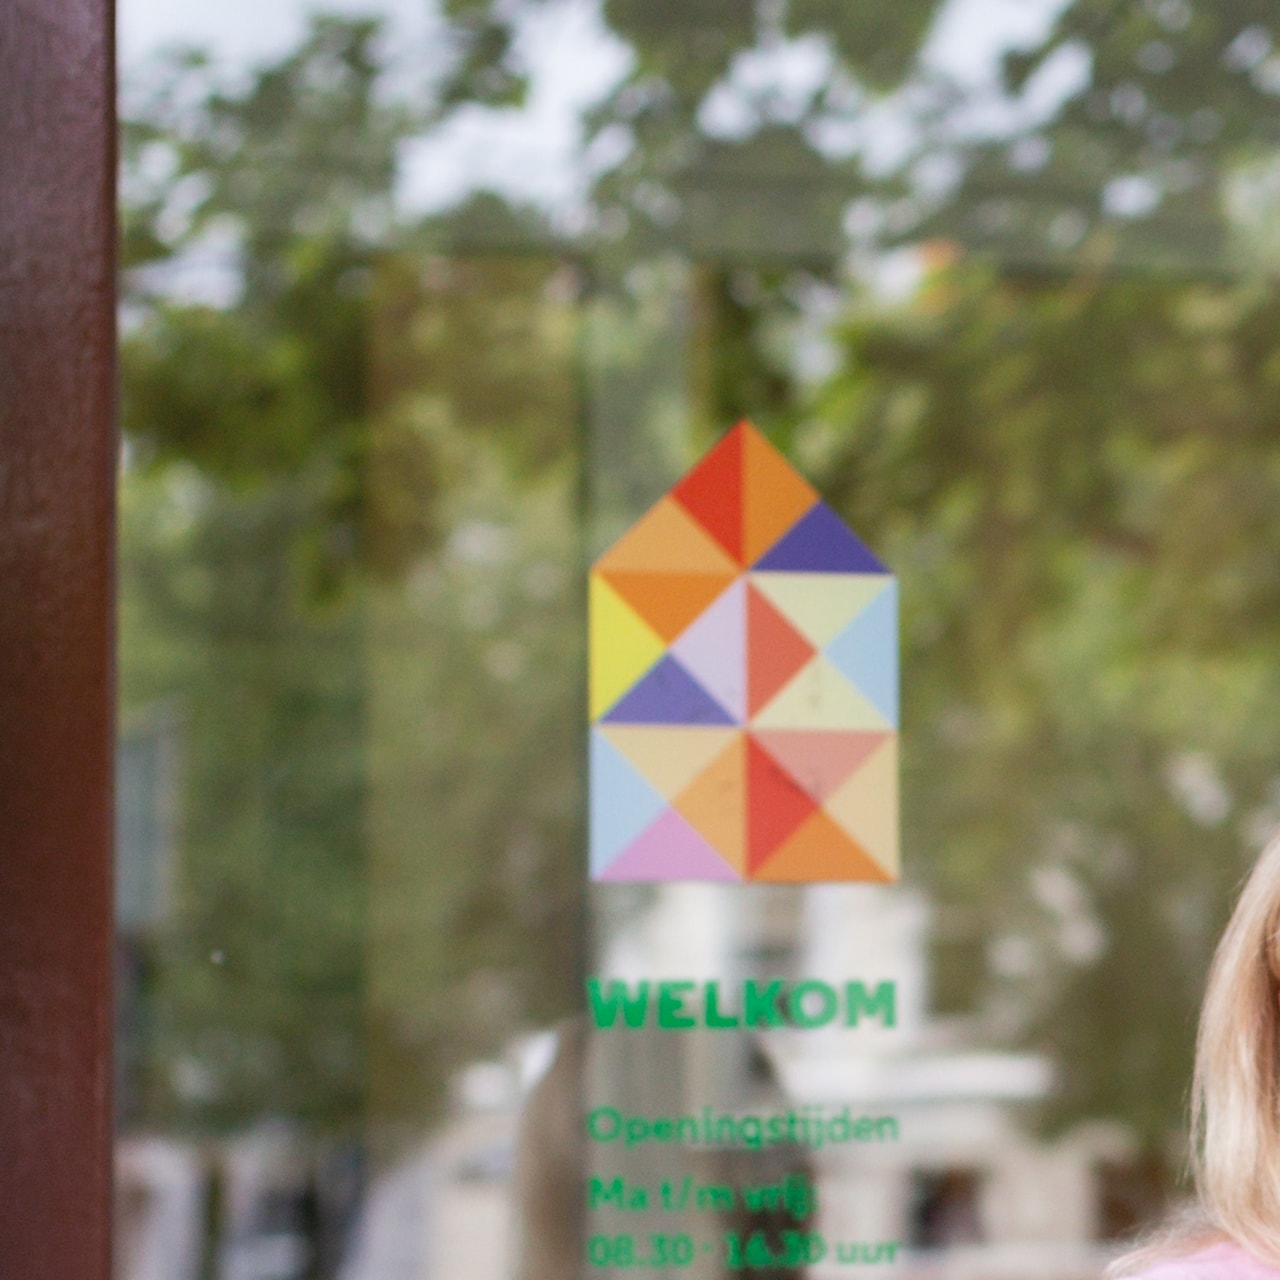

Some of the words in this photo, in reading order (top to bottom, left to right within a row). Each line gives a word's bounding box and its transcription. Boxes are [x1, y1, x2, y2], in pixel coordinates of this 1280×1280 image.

[585, 978, 898, 1029] WELKOM
[587, 1105, 899, 1151] Openingstijden
[588, 1175, 648, 1212] Ma
[660, 1175, 734, 1212] t/m
[588, 1233, 695, 1269] 08.30
[725, 1233, 828, 1269] 16.30
[835, 1241, 900, 1264] uur
